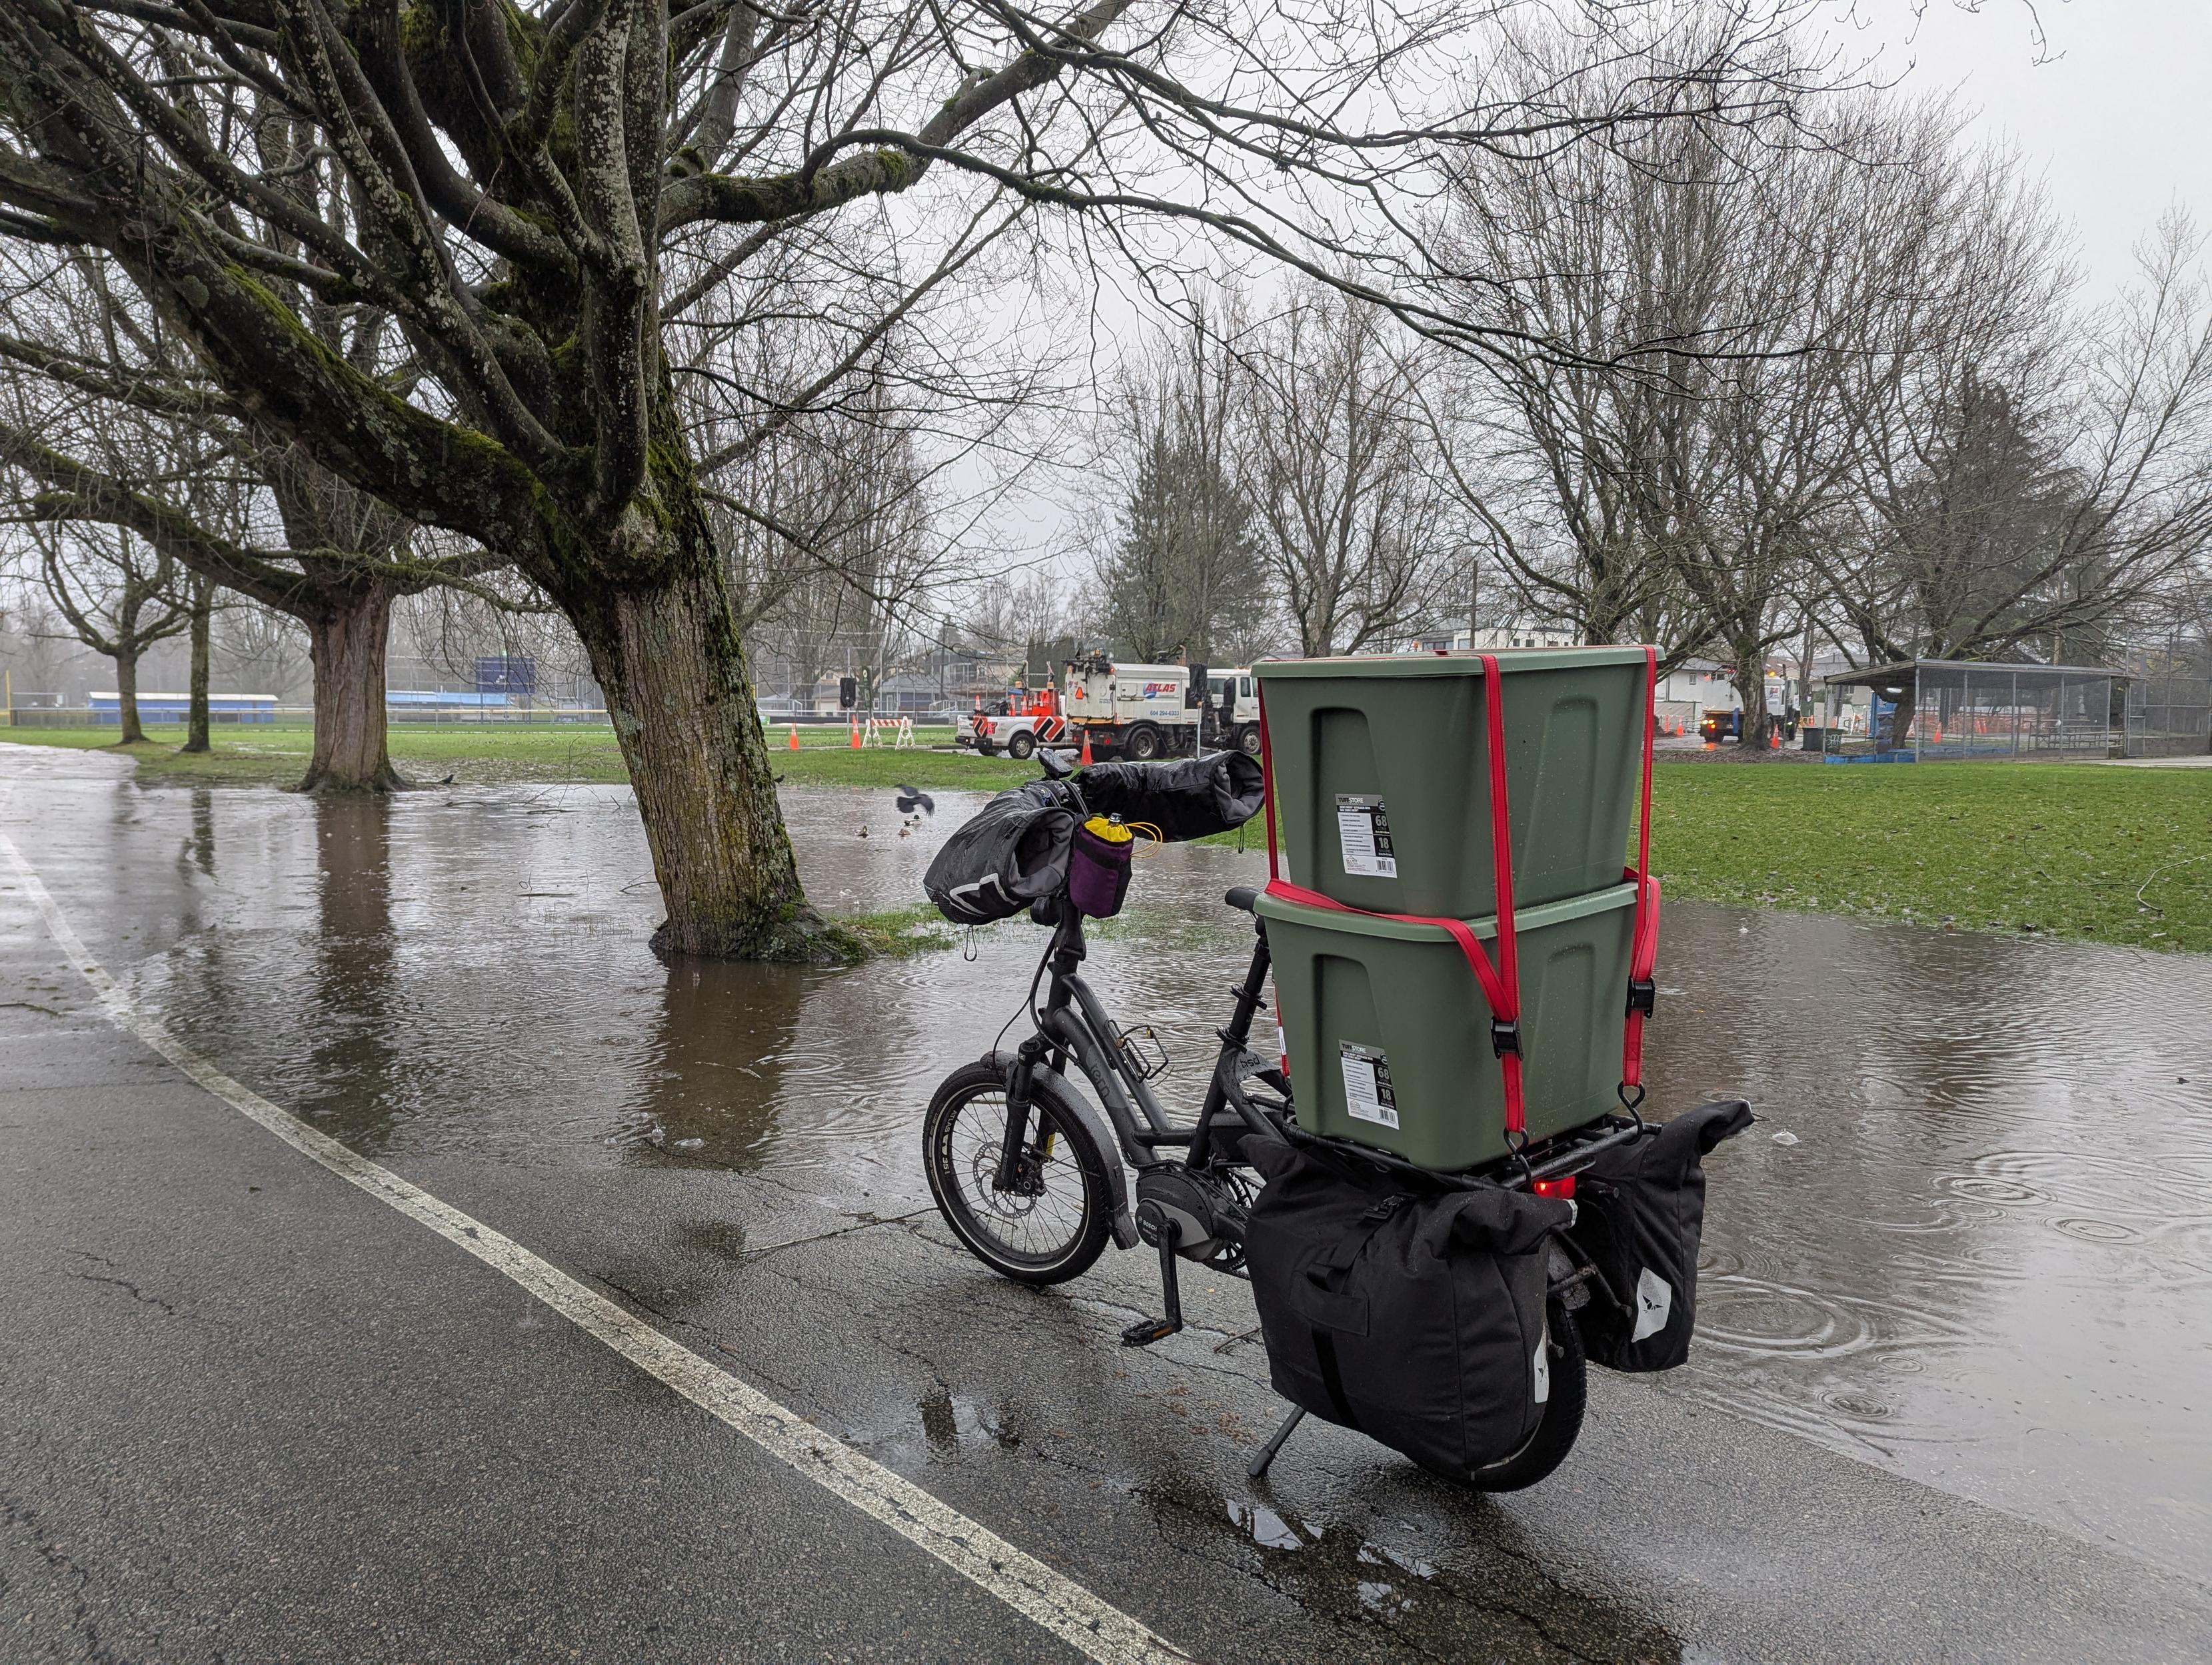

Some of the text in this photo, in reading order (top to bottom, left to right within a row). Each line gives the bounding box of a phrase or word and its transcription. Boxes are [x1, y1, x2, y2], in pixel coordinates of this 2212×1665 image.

[1145, 683, 1176, 693] ATLAS
[1375, 815, 1387, 826] 68
[1378, 837, 1390, 849] 18
[1378, 1068, 1390, 1080] 68
[1381, 1088, 1392, 1101] 18
[944, 1110, 957, 1133] ATLAS
[1143, 1220, 1158, 1231] BOSCH
